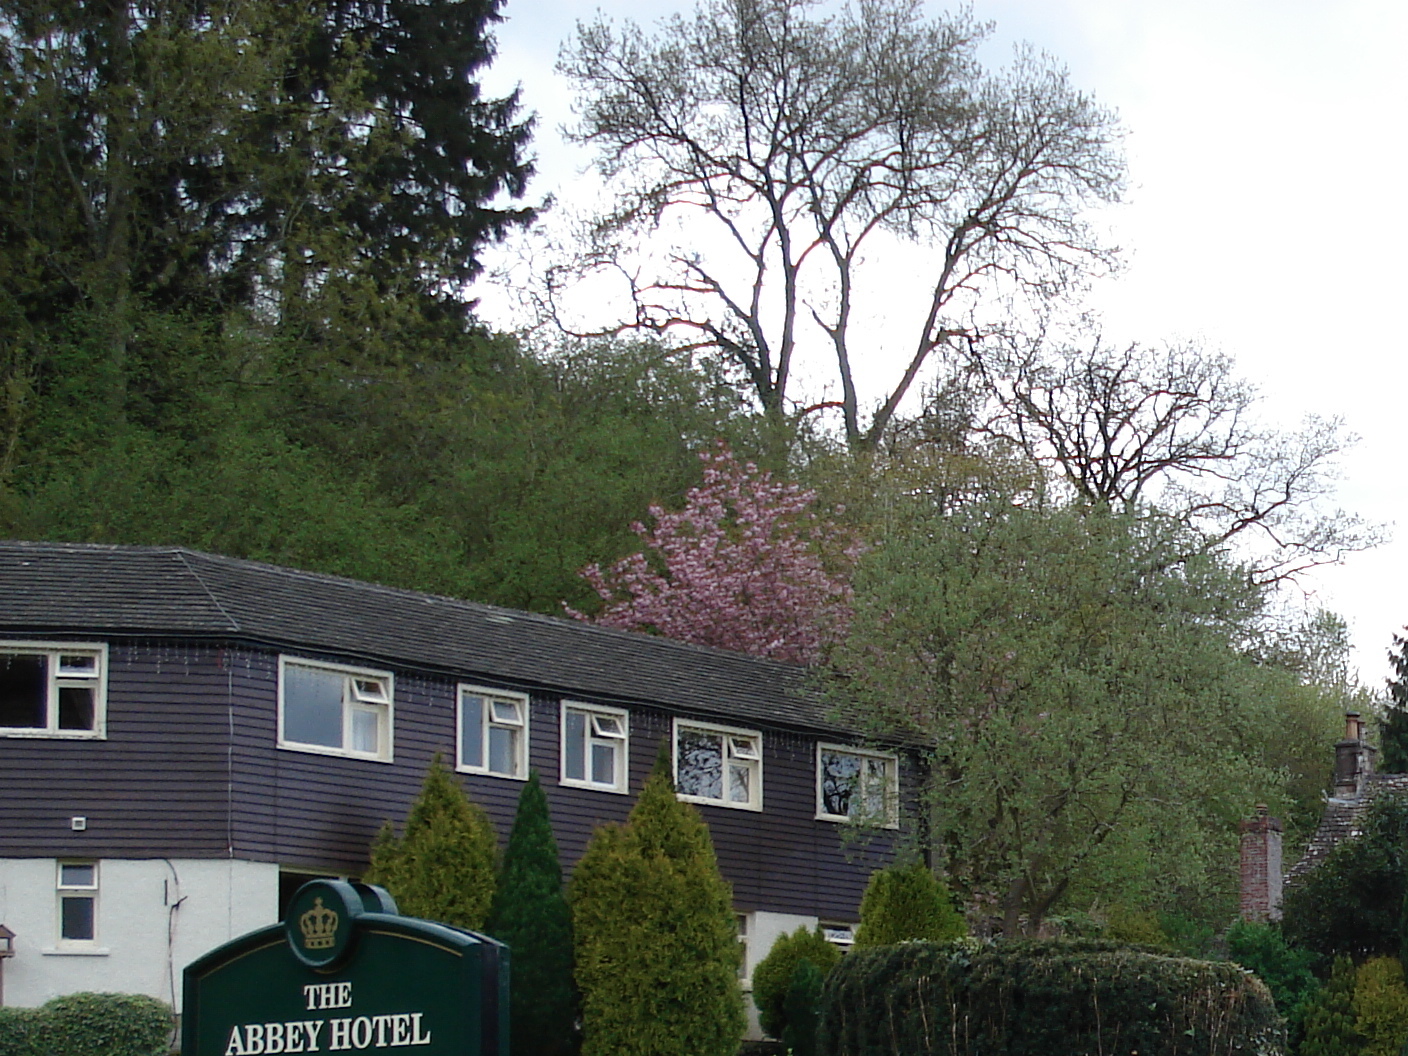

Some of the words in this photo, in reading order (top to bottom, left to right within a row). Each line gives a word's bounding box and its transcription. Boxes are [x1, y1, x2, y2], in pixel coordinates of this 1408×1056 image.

[304, 982, 352, 1010] THE
[225, 1020, 324, 1056] ABBEY
[329, 1013, 431, 1050] HOTEL
